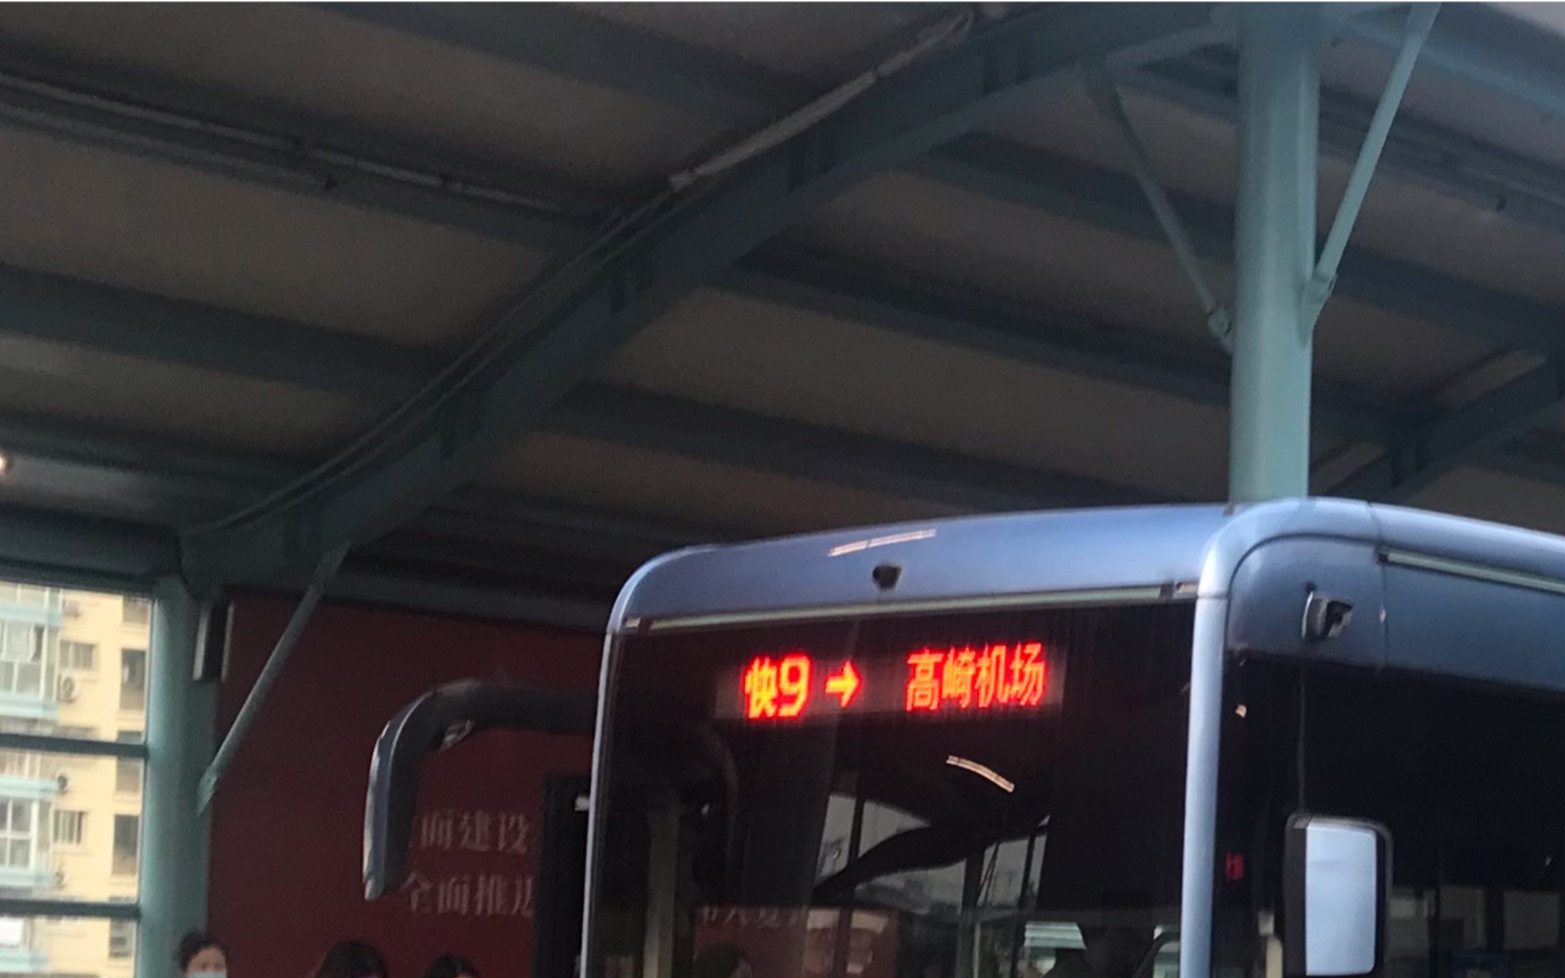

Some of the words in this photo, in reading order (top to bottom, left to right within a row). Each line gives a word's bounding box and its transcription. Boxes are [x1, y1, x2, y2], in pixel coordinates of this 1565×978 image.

[743, 652, 811, 719] 快9
[905, 642, 1046, 712] 高崎机场
[408, 808, 538, 855] 面建设
